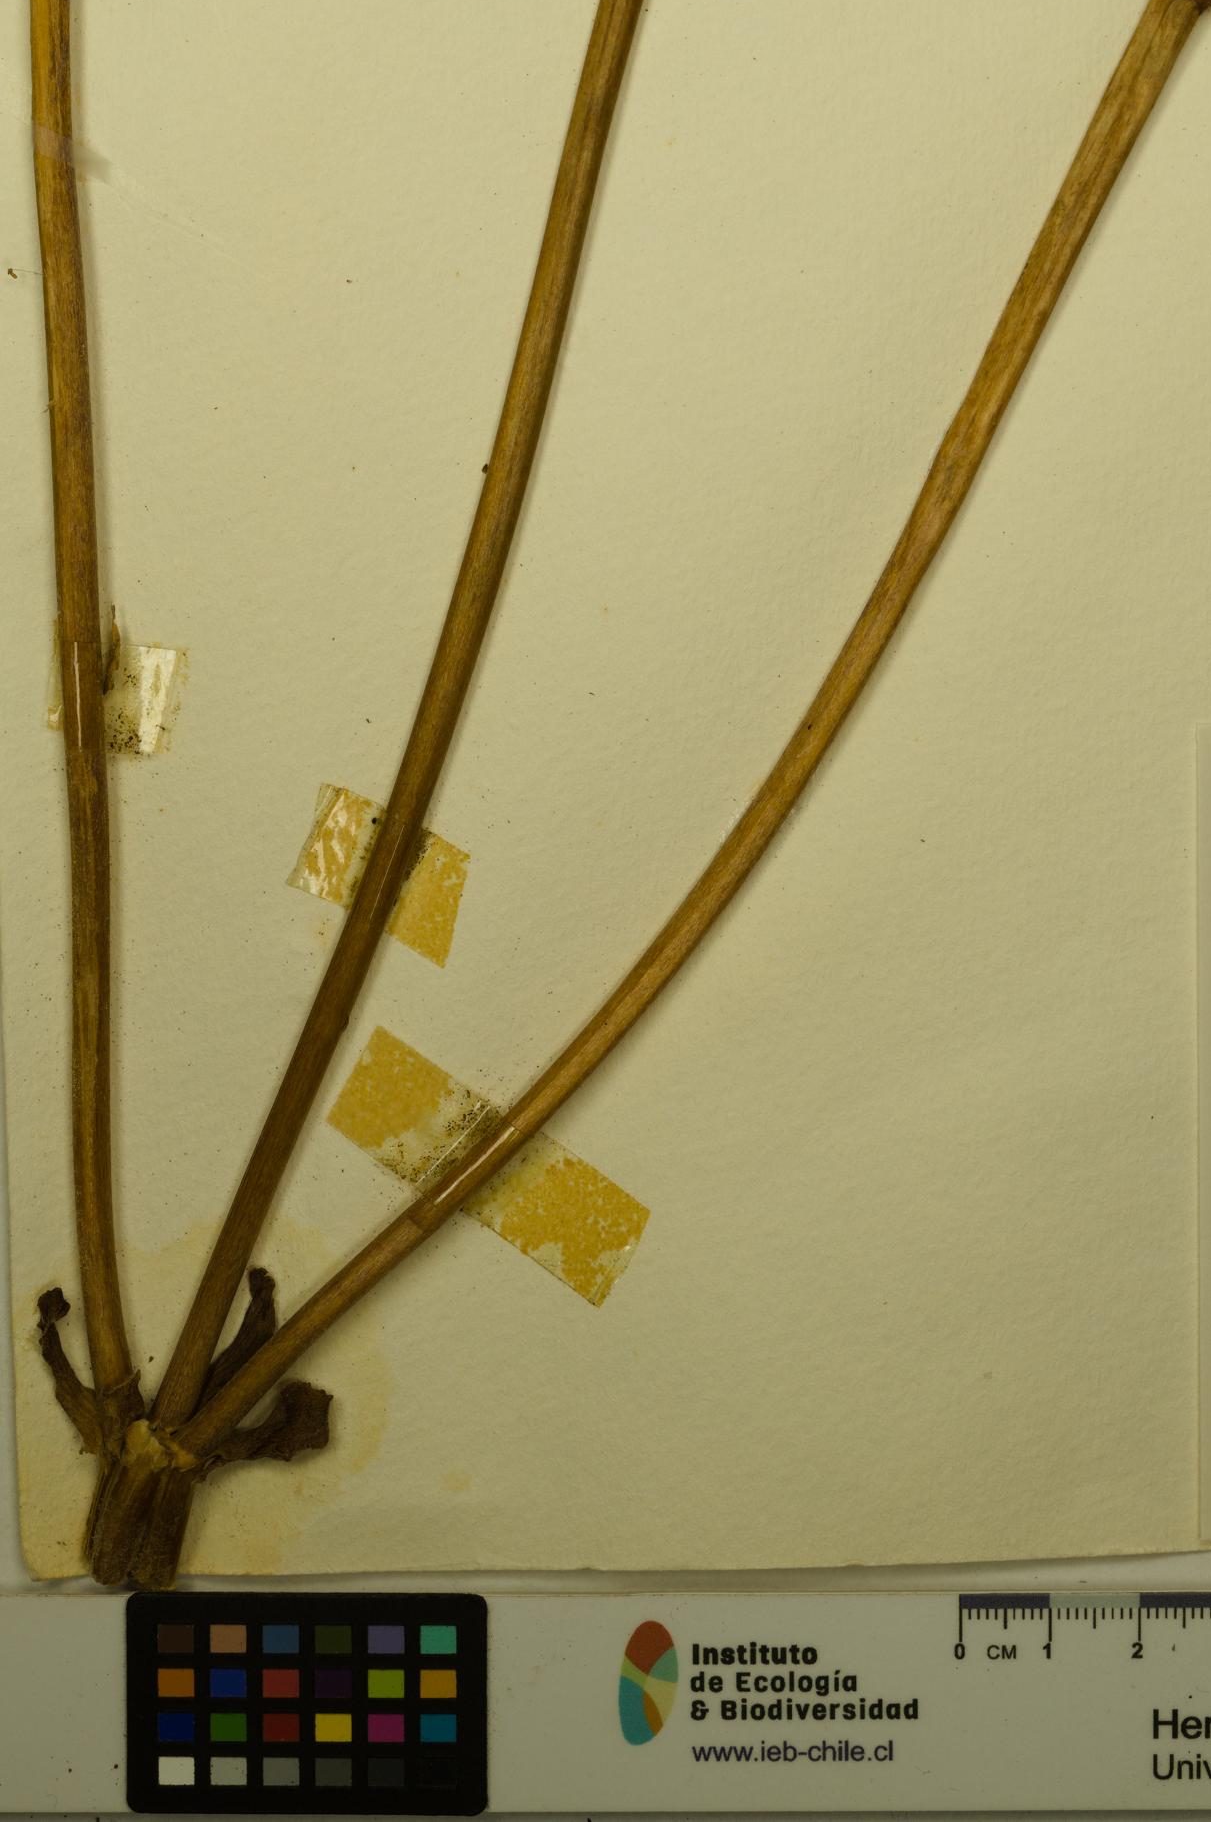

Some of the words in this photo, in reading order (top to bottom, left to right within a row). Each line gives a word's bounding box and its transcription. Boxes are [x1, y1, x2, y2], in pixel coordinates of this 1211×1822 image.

[692, 1642, 818, 1666] Instituto
[954, 1643, 965, 1658] 0
[986, 1645, 1017, 1659] CM
[1043, 1643, 1052, 1658] 1
[1132, 1642, 1143, 1657] 2
[691, 1670, 724, 1693] de
[736, 1669, 858, 1698] Ecología
[691, 1700, 711, 1720] &
[720, 1698, 919, 1720] Biodiversidad
[692, 1740, 894, 1762] www.ieb-chile.cl
